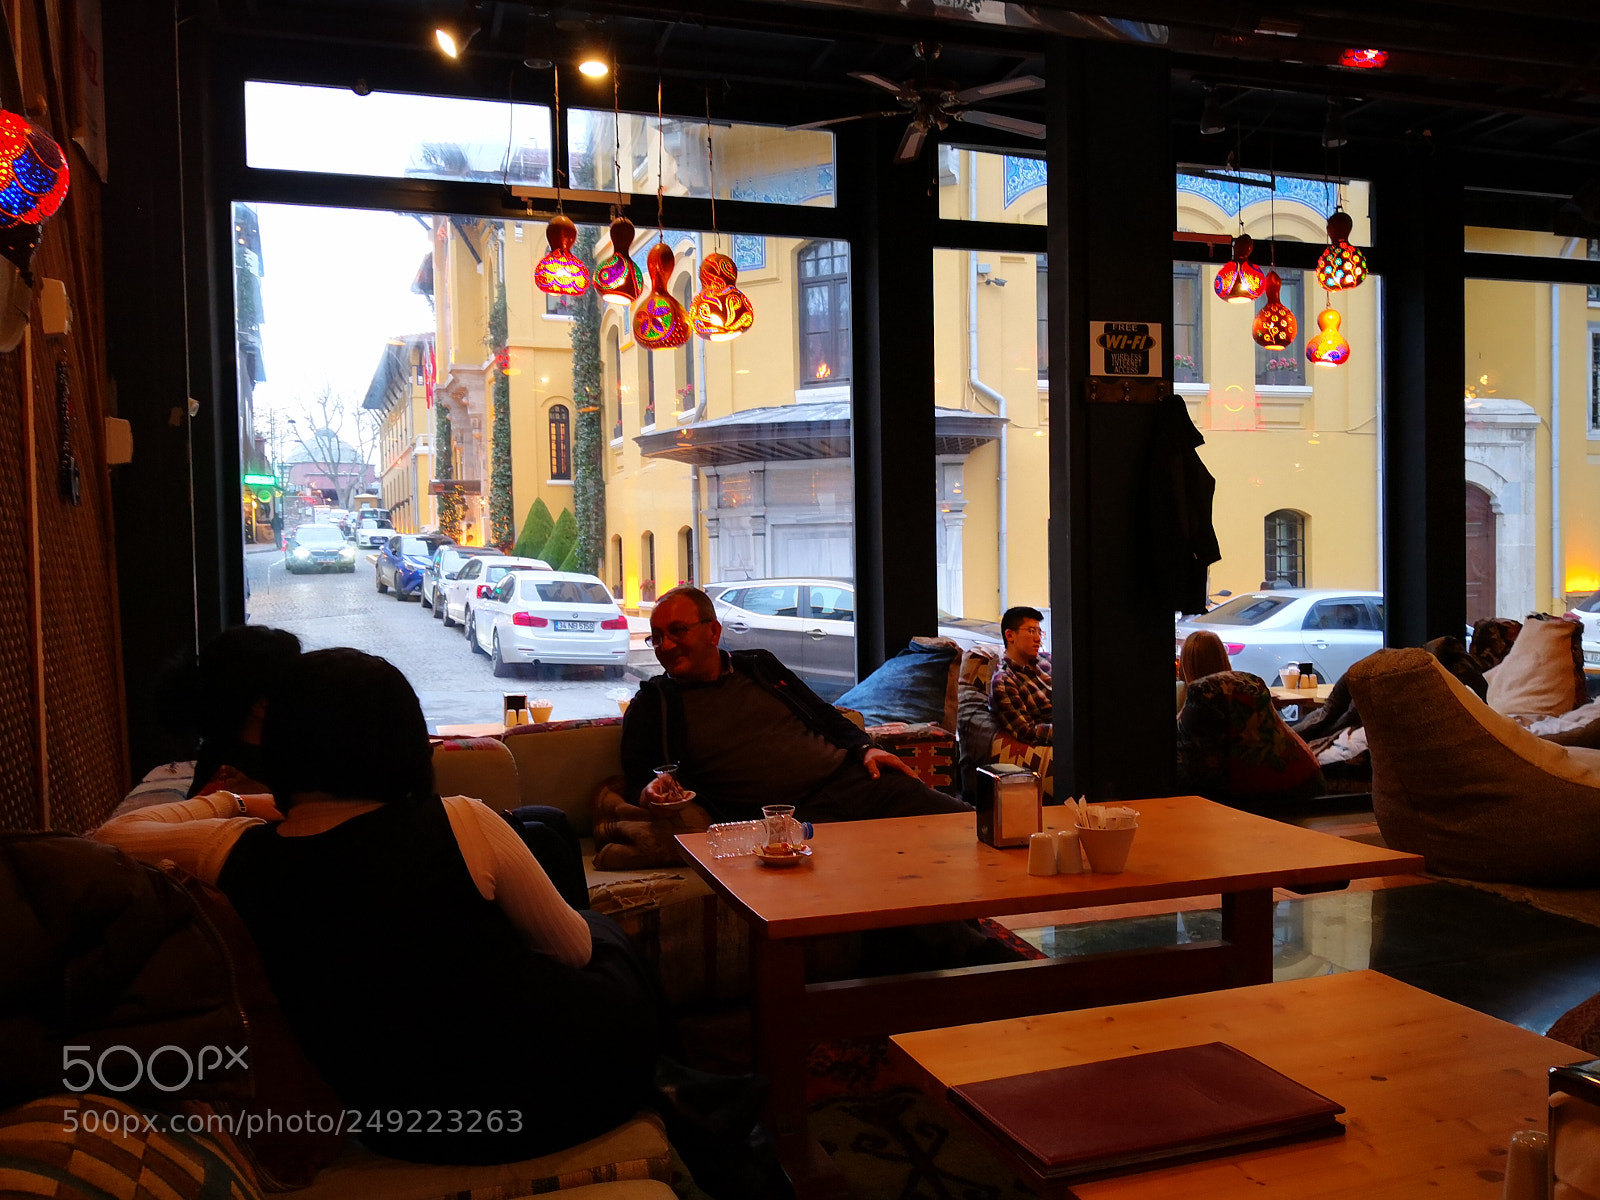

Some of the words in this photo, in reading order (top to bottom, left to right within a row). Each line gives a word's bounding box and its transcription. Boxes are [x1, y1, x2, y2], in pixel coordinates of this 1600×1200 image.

[1112, 323, 1138, 332] FREE
[1105, 334, 1147, 350] WI-FI
[1111, 352, 1142, 360] WIRELESS
[1114, 366, 1139, 374] ACCESS
[559, 621, 567, 629] 34
